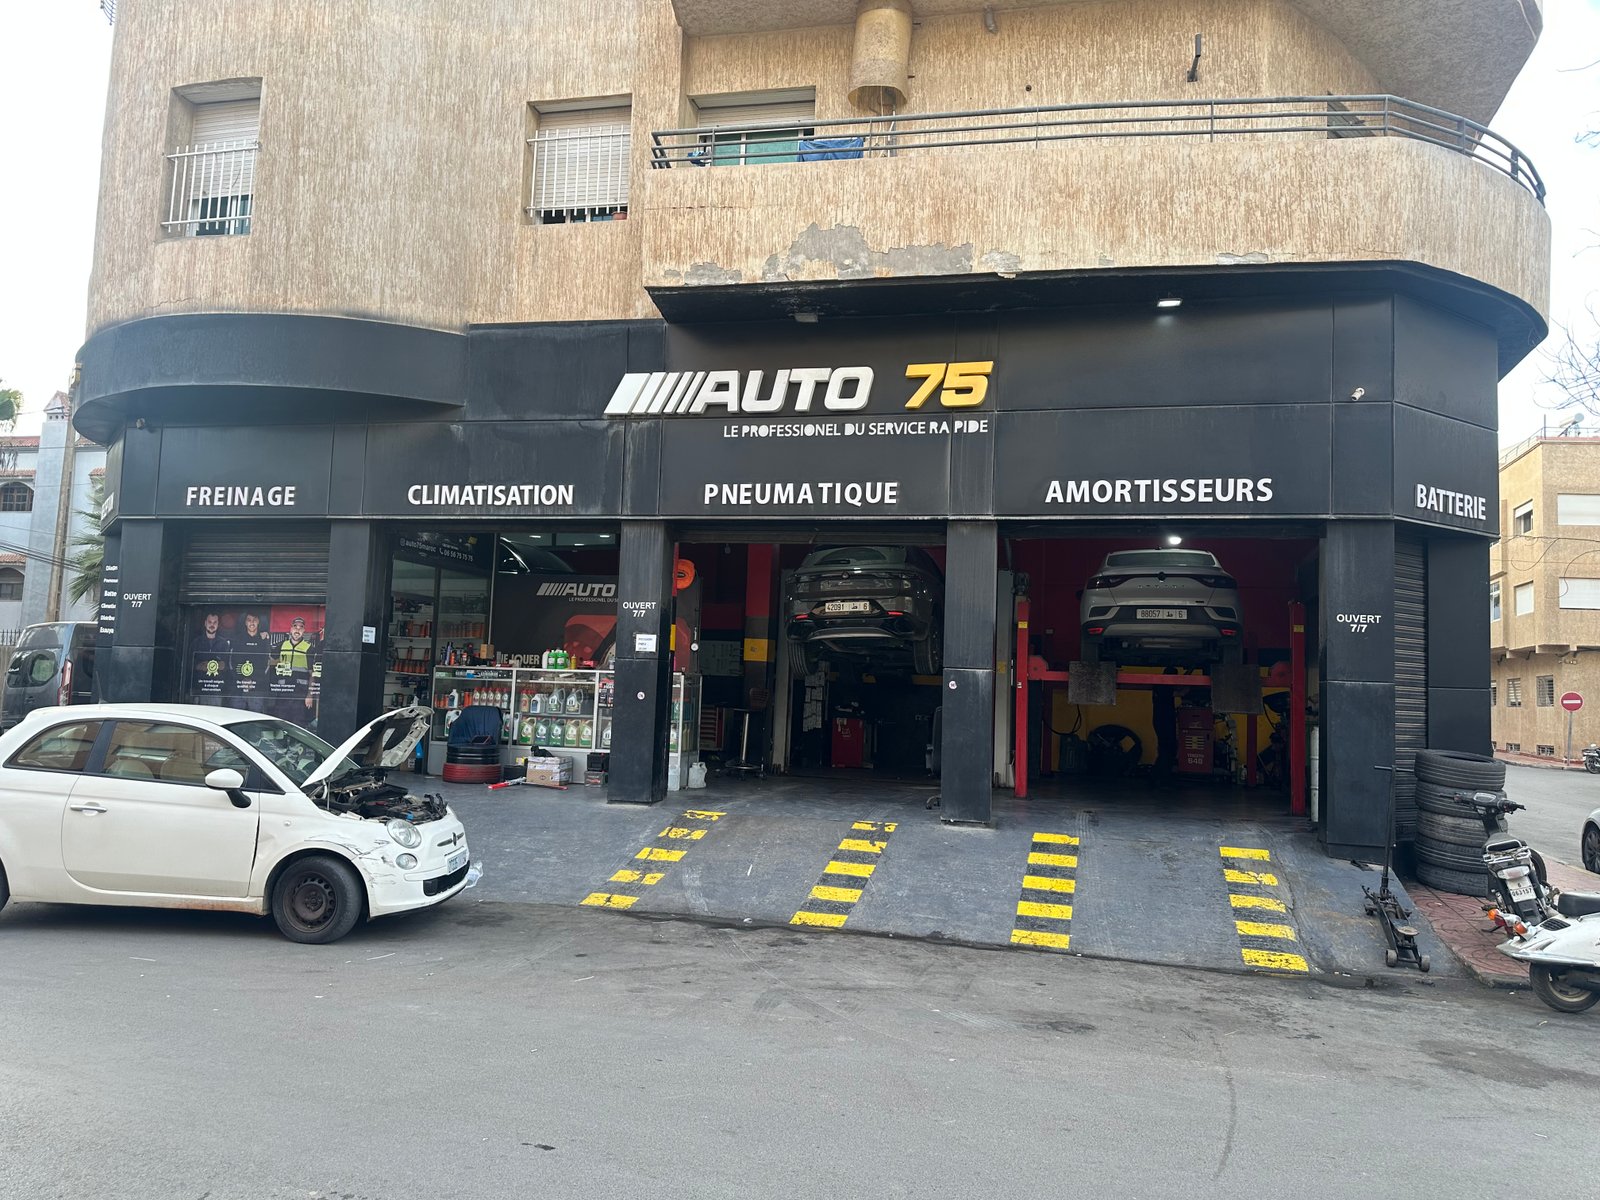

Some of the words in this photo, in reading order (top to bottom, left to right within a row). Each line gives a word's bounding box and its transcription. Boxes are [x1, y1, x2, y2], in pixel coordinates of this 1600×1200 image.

[688, 366, 875, 414] AUTO
[904, 361, 994, 410] 75
[723, 425, 739, 438] LE
[741, 423, 841, 438] PROFESSIONEL
[844, 422, 866, 436] DU
[868, 421, 927, 436] SERVICE
[186, 486, 296, 506] FREINAGE
[407, 484, 575, 506] CLIMATISATION
[703, 481, 899, 507] PNEUMATIQUE
[1044, 477, 1274, 503] AMORTISSEURS
[1415, 483, 1487, 521] BATTERIE
[123, 593, 152, 601] OUVERT
[562, 583, 616, 597] AUTO
[622, 601, 657, 610] OUVERT
[863, 602, 868, 610] 6
[632, 610, 646, 618] 7/7
[1178, 610, 1184, 618] 6
[1336, 613, 1382, 624] OUVERT
[1349, 624, 1368, 633] 7/7
